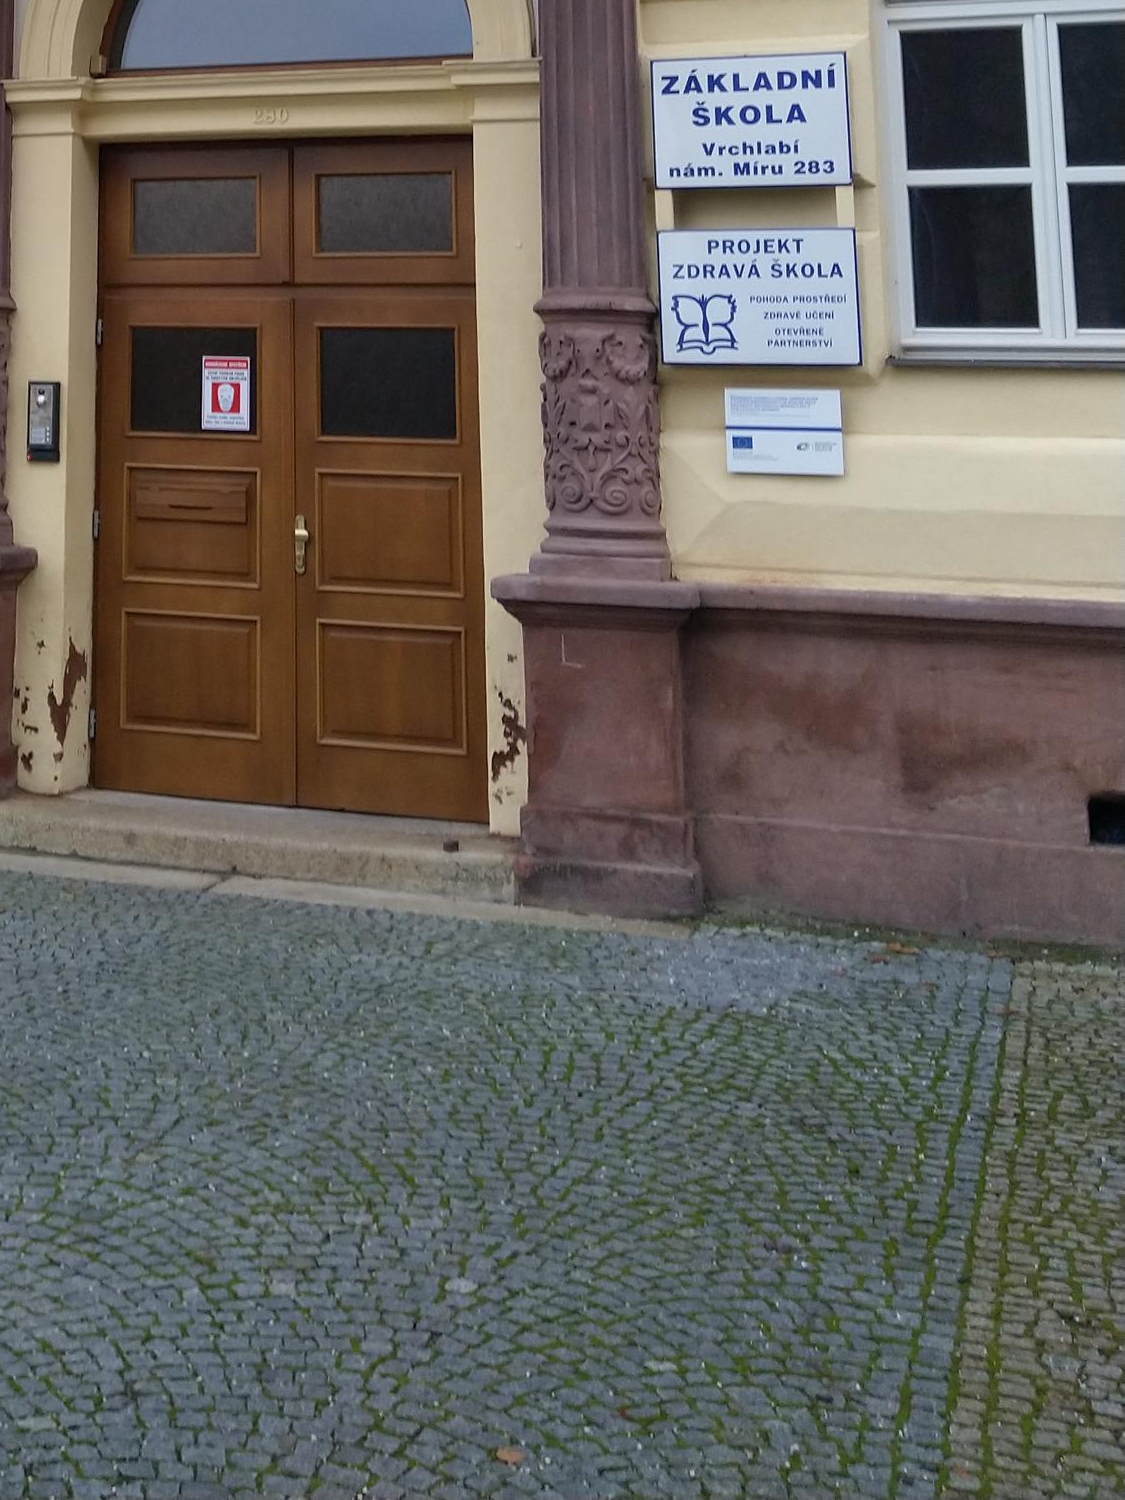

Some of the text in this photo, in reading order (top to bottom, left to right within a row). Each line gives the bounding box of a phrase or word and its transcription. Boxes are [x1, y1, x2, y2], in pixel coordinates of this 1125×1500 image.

[661, 62, 837, 96] ZÁKLADNÍ
[691, 101, 808, 127] ŠKOLA
[701, 139, 800, 157] Vrchlabí
[669, 160, 835, 178] nám. Míru 283
[707, 238, 804, 255] PROJEKT
[672, 258, 844, 280] ZDRAVÁ ŠKOLA
[749, 294, 847, 304] POHODA PROSTŘEDÍ
[763, 310, 835, 320] ZDRAVÉ UČENÍ
[774, 326, 824, 336] OTEVŘENÉ
[766, 337, 833, 348] PARTNERSTVÍ
